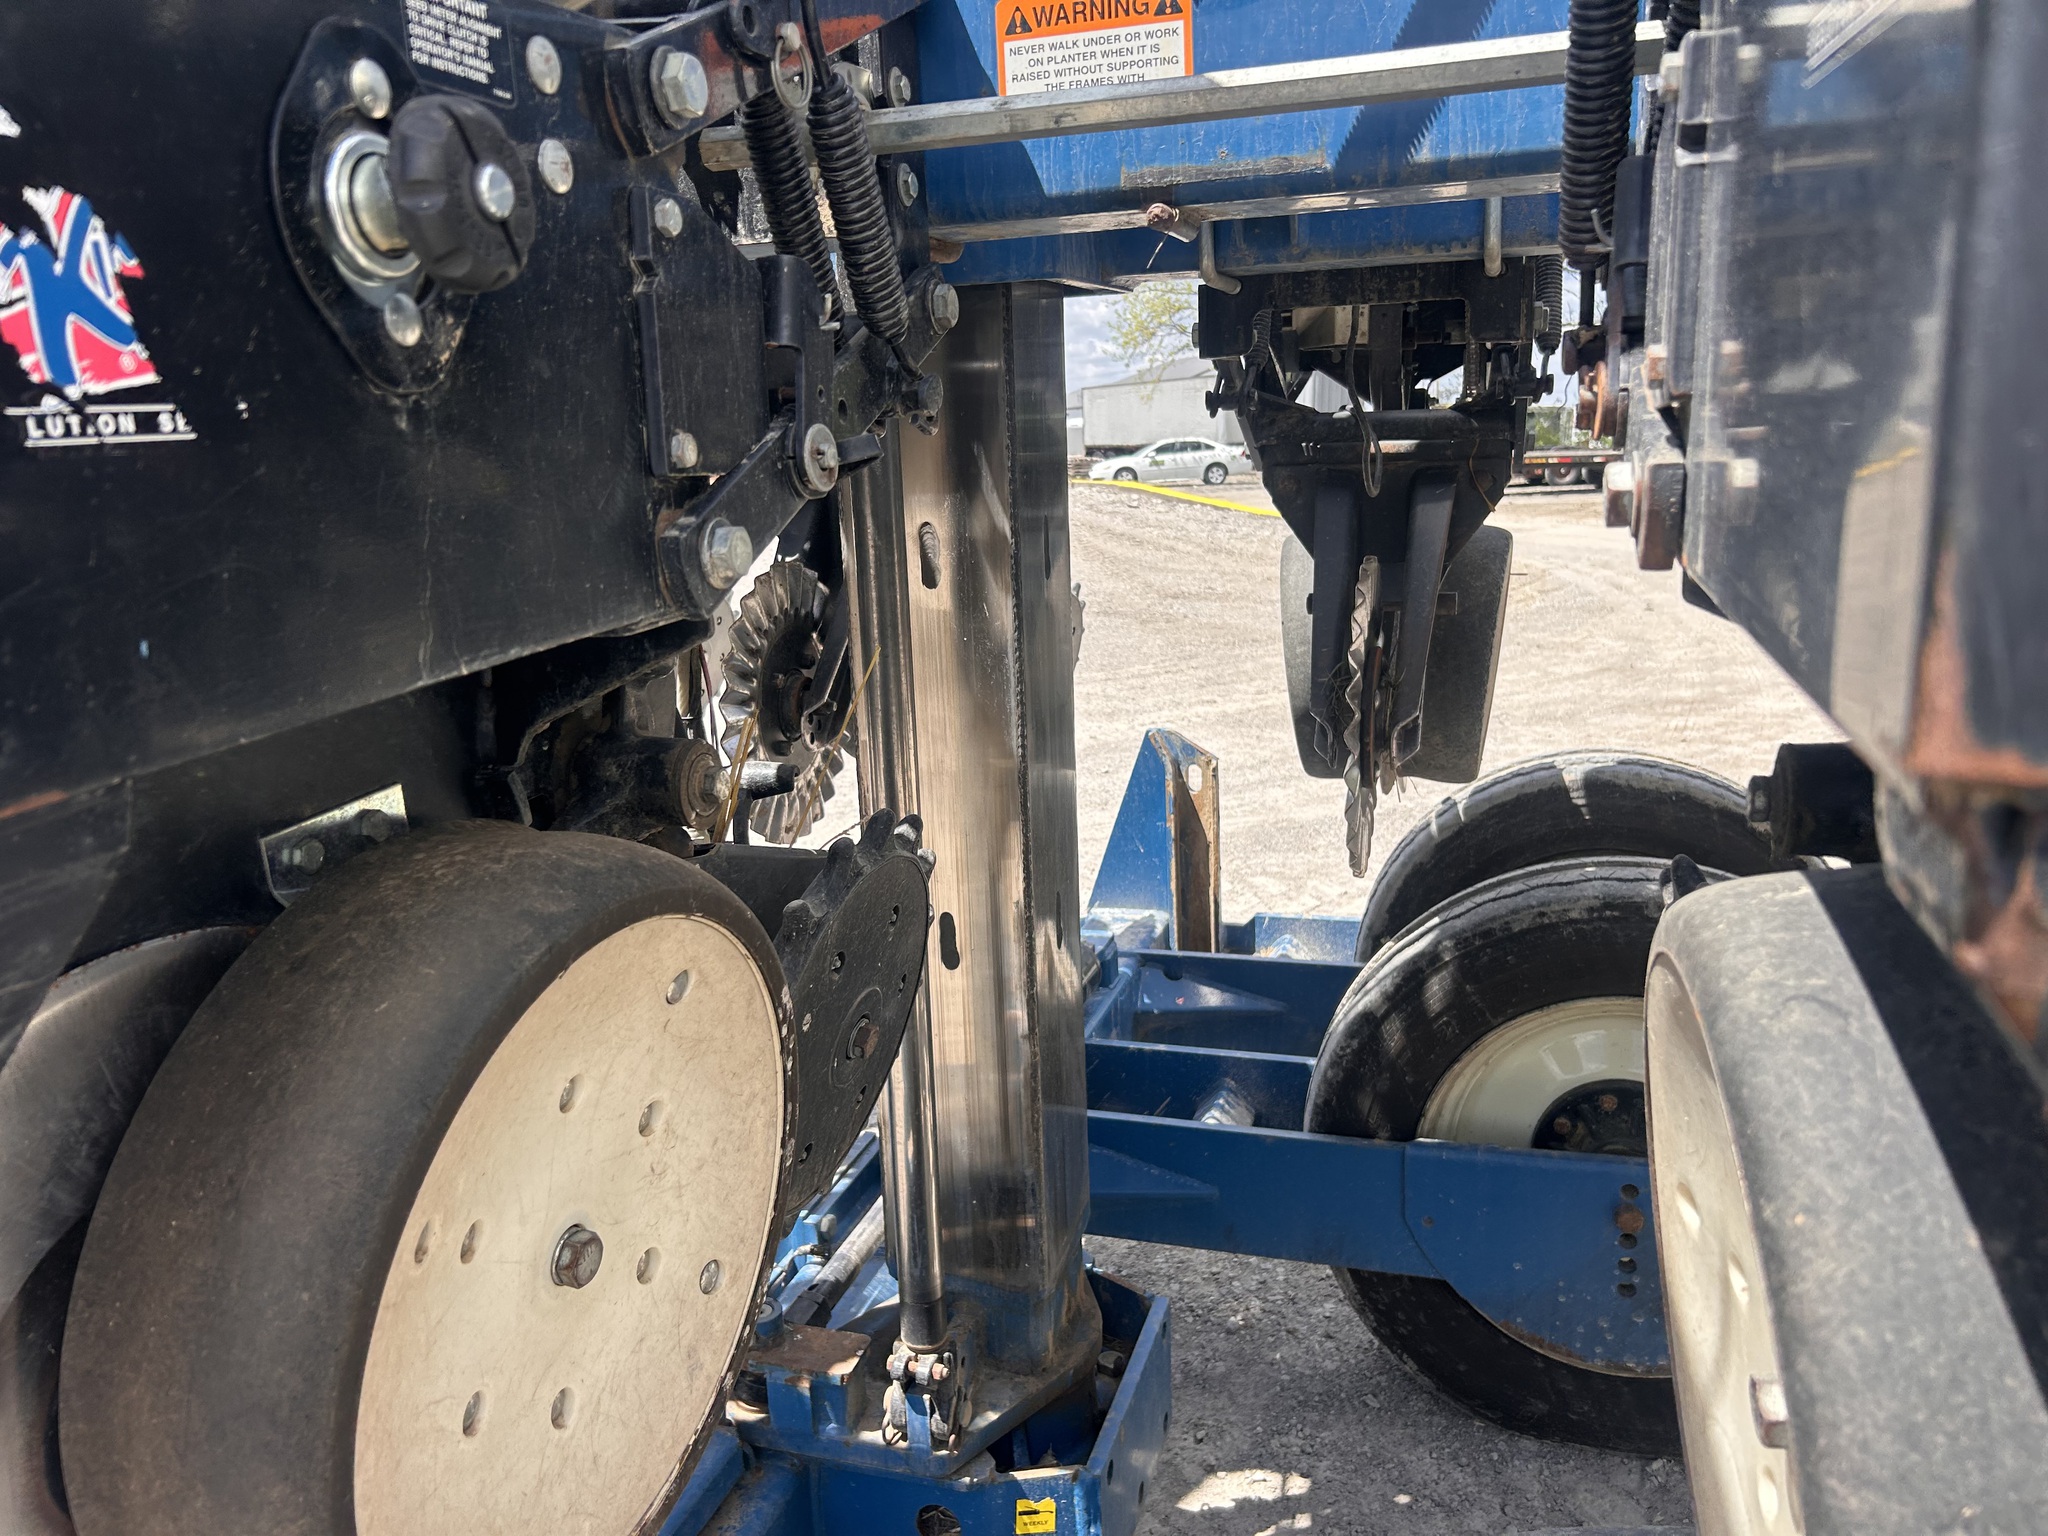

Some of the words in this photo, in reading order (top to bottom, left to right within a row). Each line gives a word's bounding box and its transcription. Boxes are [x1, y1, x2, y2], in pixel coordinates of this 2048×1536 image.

[408, 8, 420, 22] TO
[420, 13, 446, 32] DRIVE
[447, 22, 478, 43] CLUTCH
[1032, 0, 1150, 28] WARNING
[449, 36, 475, 57] REFER
[477, 46, 489, 60] TO
[1009, 43, 1045, 57] NEVER
[1048, 39, 1079, 52] WALK
[1082, 33, 1121, 48] UNDER
[1124, 31, 1141, 43] OR
[1144, 26, 1179, 40] WORK
[411, 50, 429, 66] FOR
[1027, 57, 1044, 68] ON
[1046, 50, 1097, 66] PLANTER
[1100, 46, 1134, 60] WHEN
[1136, 44, 1147, 56] IT
[1150, 43, 1161, 54] IS
[1011, 70, 1051, 84] RAISED
[1053, 64, 1104, 79] WITHOUT
[1106, 55, 1179, 72] SUPPORTING
[1044, 81, 1066, 92] THE
[1068, 76, 1114, 90] FRAMES
[1117, 72, 1145, 85] WITH
[25, 411, 137, 438] LUTON
